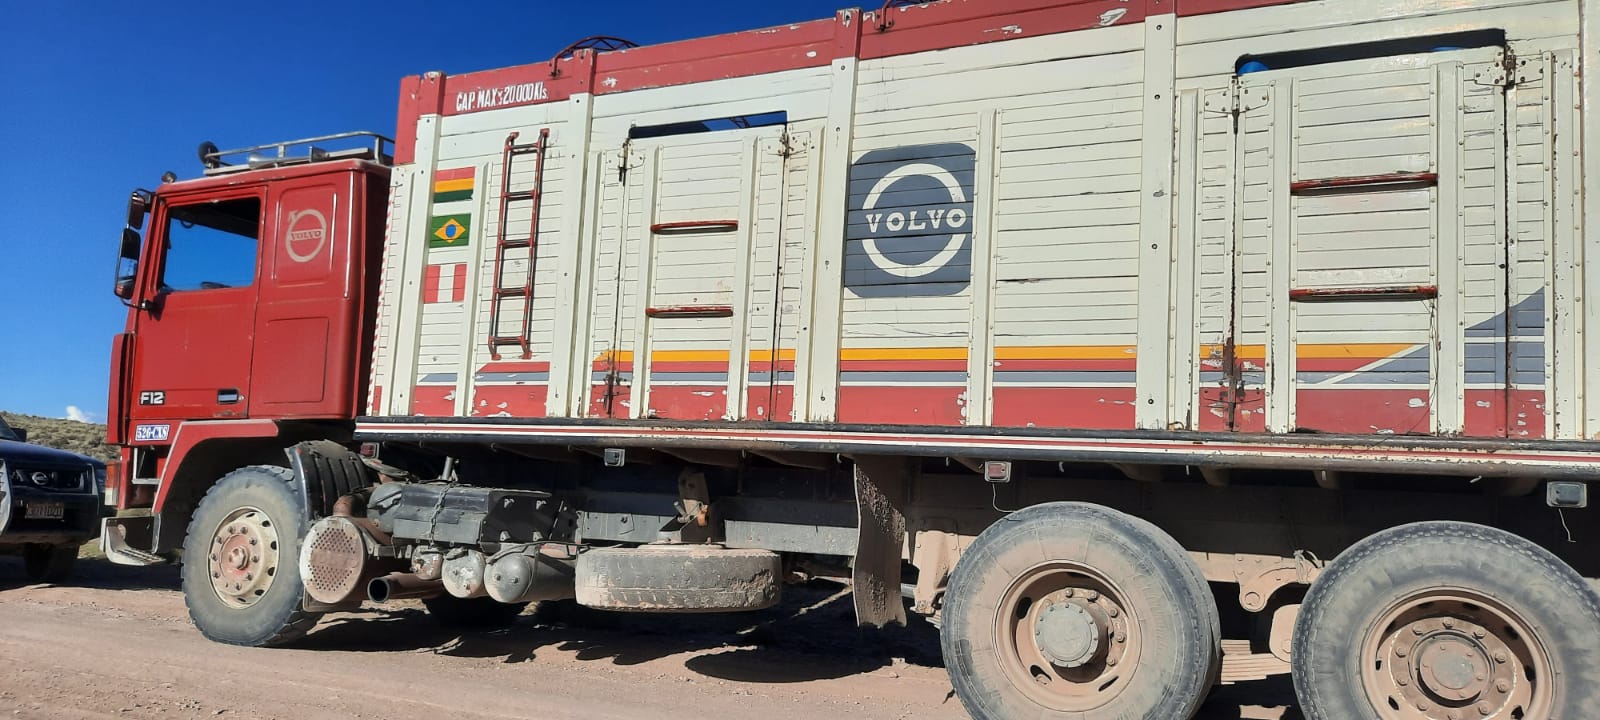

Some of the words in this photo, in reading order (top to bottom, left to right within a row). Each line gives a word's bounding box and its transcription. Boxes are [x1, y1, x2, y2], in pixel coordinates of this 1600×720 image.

[865, 208, 967, 233] VOLVO
[291, 230, 322, 241] VOLVO
[140, 391, 164, 405] F12
